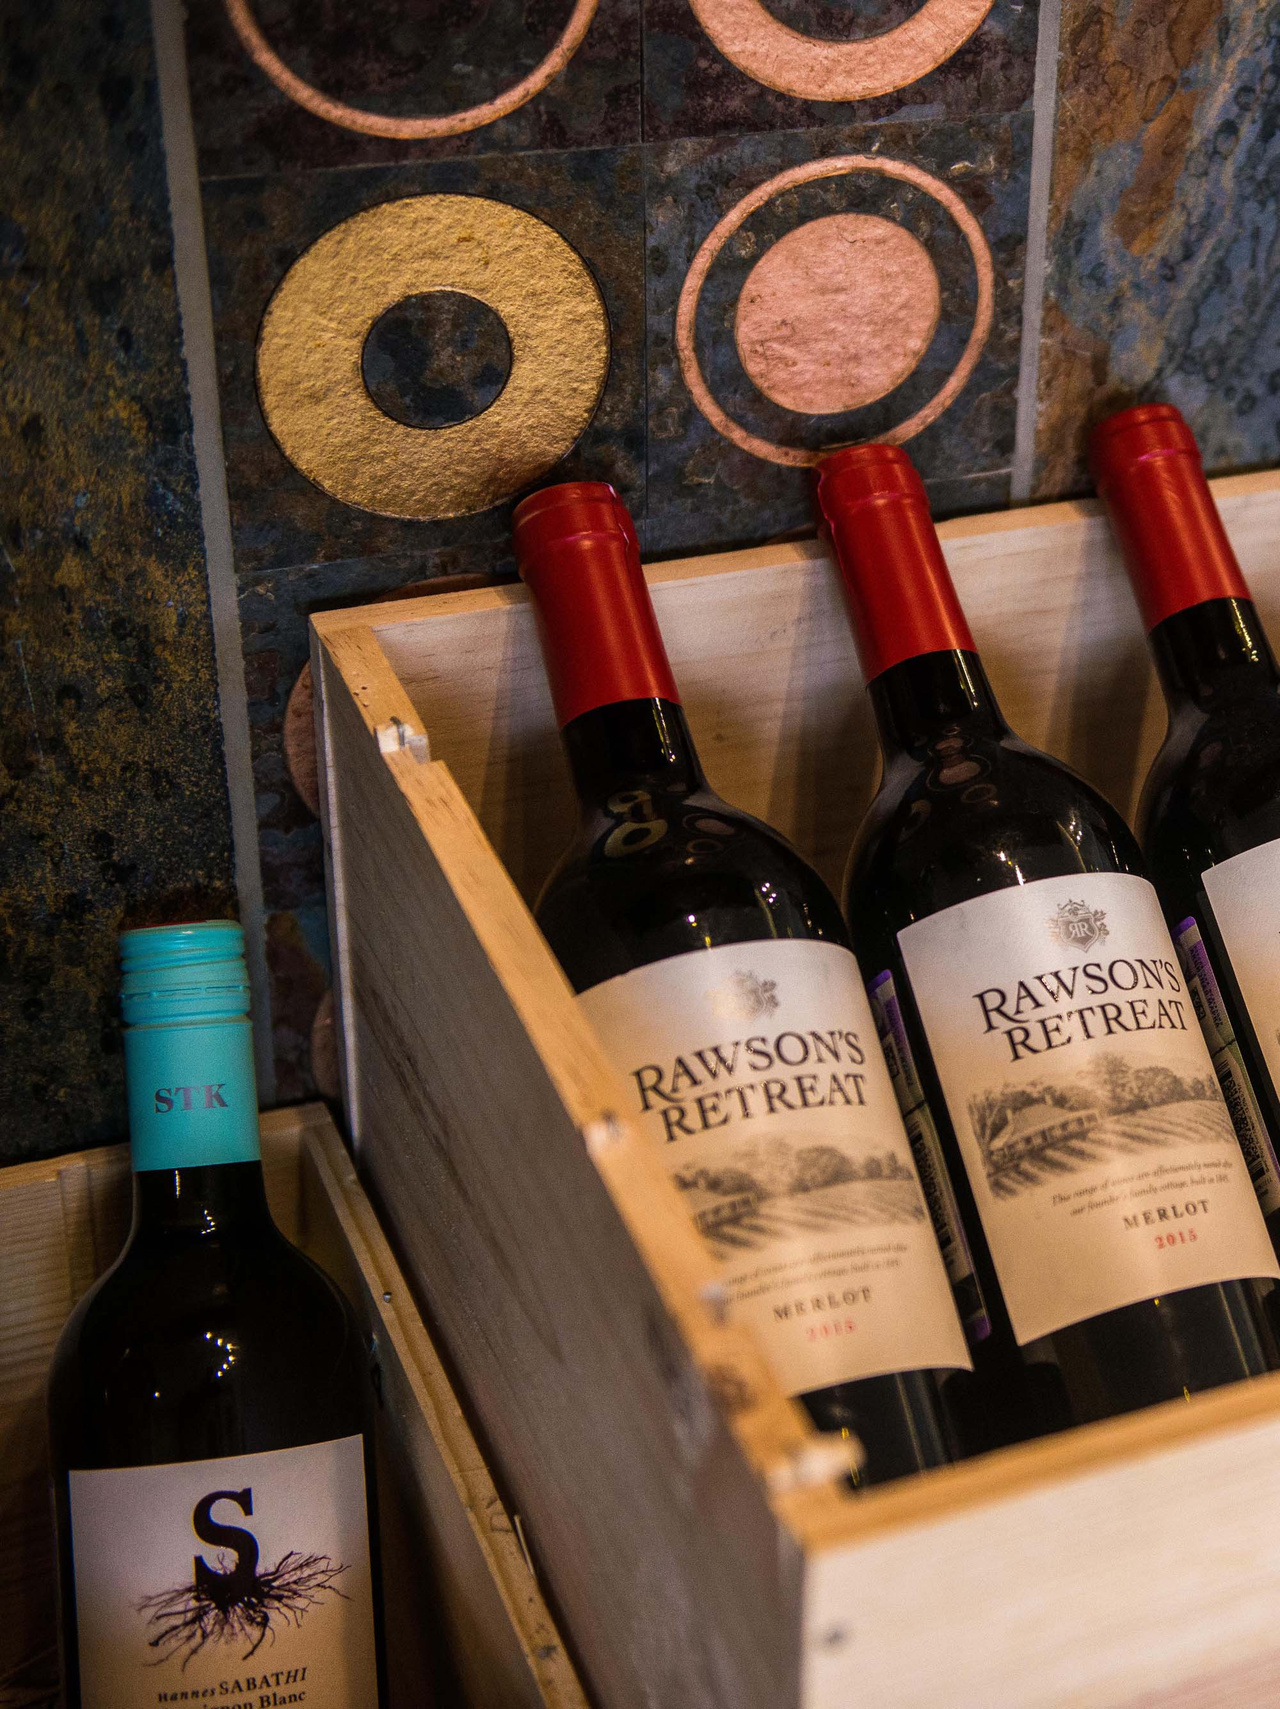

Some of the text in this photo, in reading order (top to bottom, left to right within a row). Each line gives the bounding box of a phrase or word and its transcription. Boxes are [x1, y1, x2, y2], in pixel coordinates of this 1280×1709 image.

[972, 958, 1181, 1034] RAWSON'S
[1001, 999, 1188, 1062] RETREAT
[632, 1030, 866, 1114] RAWSON'S
[154, 1083, 229, 1113] STK
[660, 1074, 867, 1143] RETREAT
[1122, 1199, 1211, 1231] MERLOT
[1154, 1227, 1198, 1250] 2015
[773, 1286, 873, 1322] MERLOT
[219, 1667, 308, 1696] SABATHI
[259, 1691, 306, 1709] Blanc
